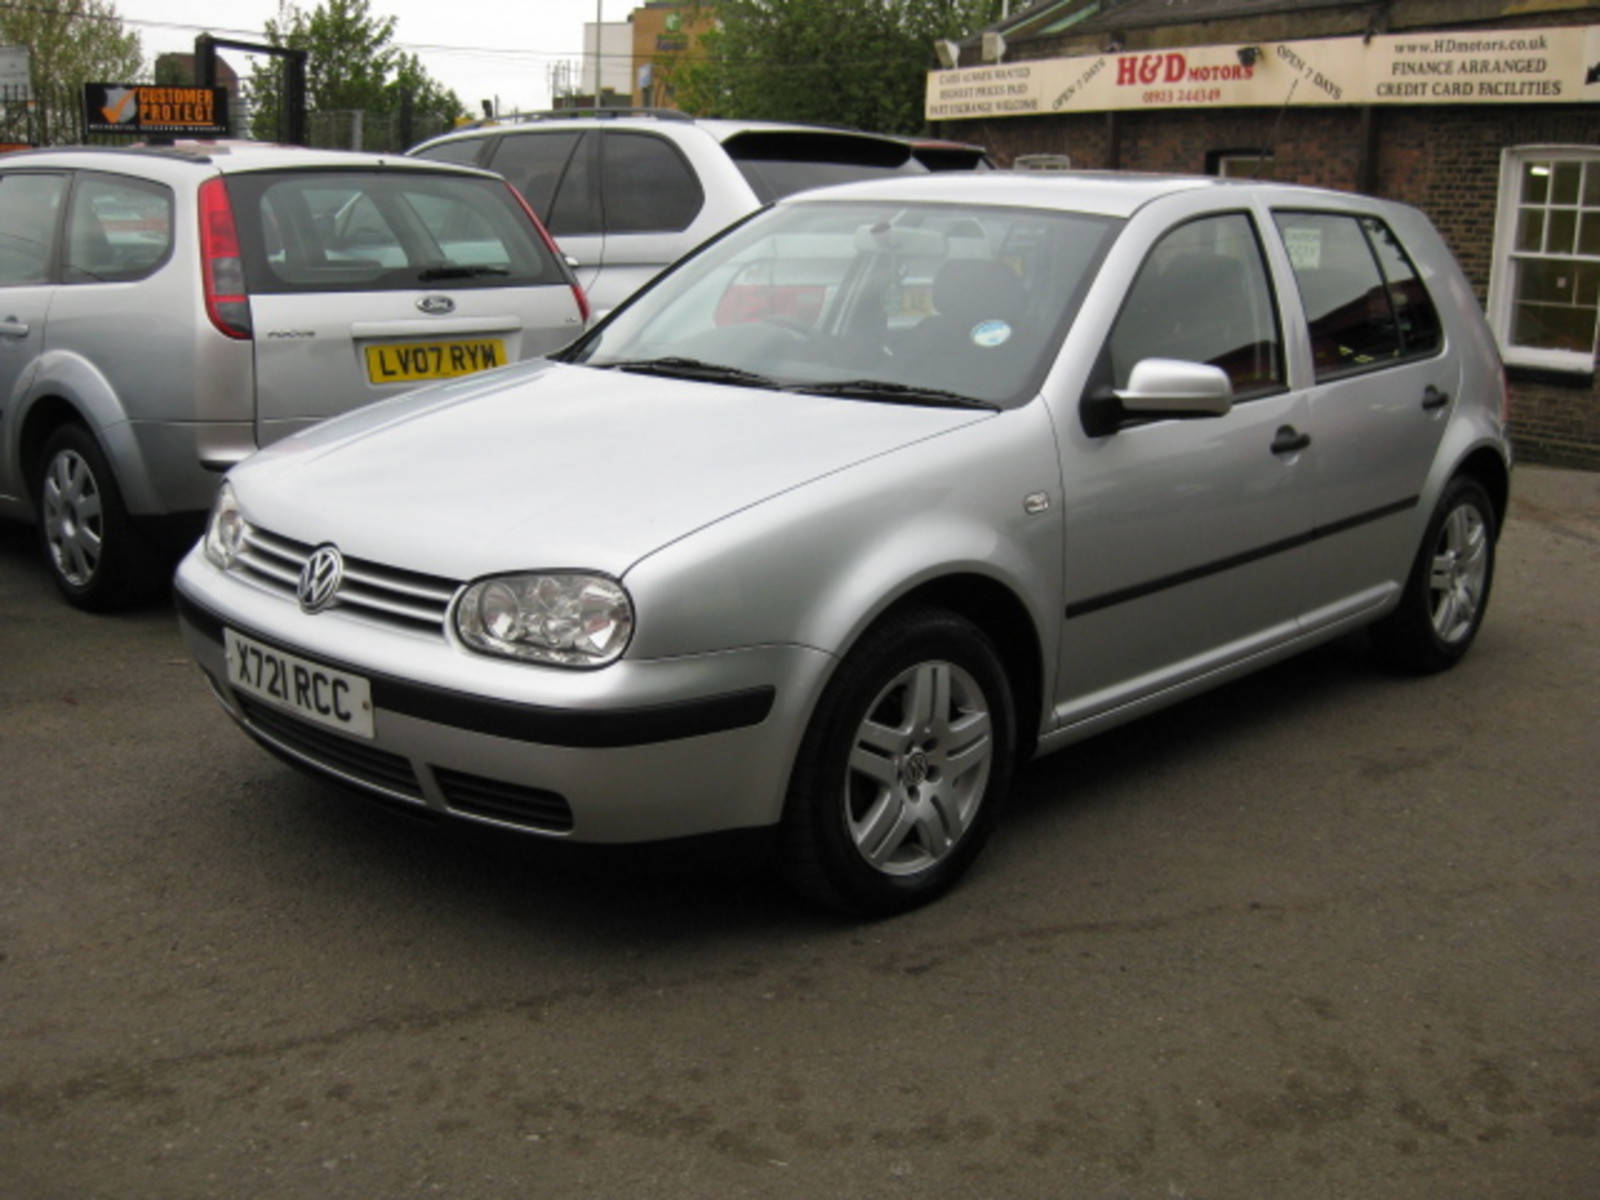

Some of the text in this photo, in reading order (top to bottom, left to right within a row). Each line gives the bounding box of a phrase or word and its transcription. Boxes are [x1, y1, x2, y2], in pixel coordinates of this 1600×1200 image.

[1394, 35, 1547, 54] www.HDmotors.co.uk
[1115, 52, 1254, 86] H&D MOTORS
[1277, 45, 1343, 101] OPEN 7 DAYS
[1391, 58, 1547, 76] FINANCE ARRANGED
[139, 86, 213, 103] CUSTOMER
[1052, 86, 1076, 111] OPEN
[1083, 57, 1107, 83] DAYS
[1376, 79, 1562, 97] CREDIT CARD FACILITIES
[139, 103, 213, 121] PROTECT
[379, 343, 498, 376] LV07 RYM
[236, 639, 352, 722] X721 RCC
